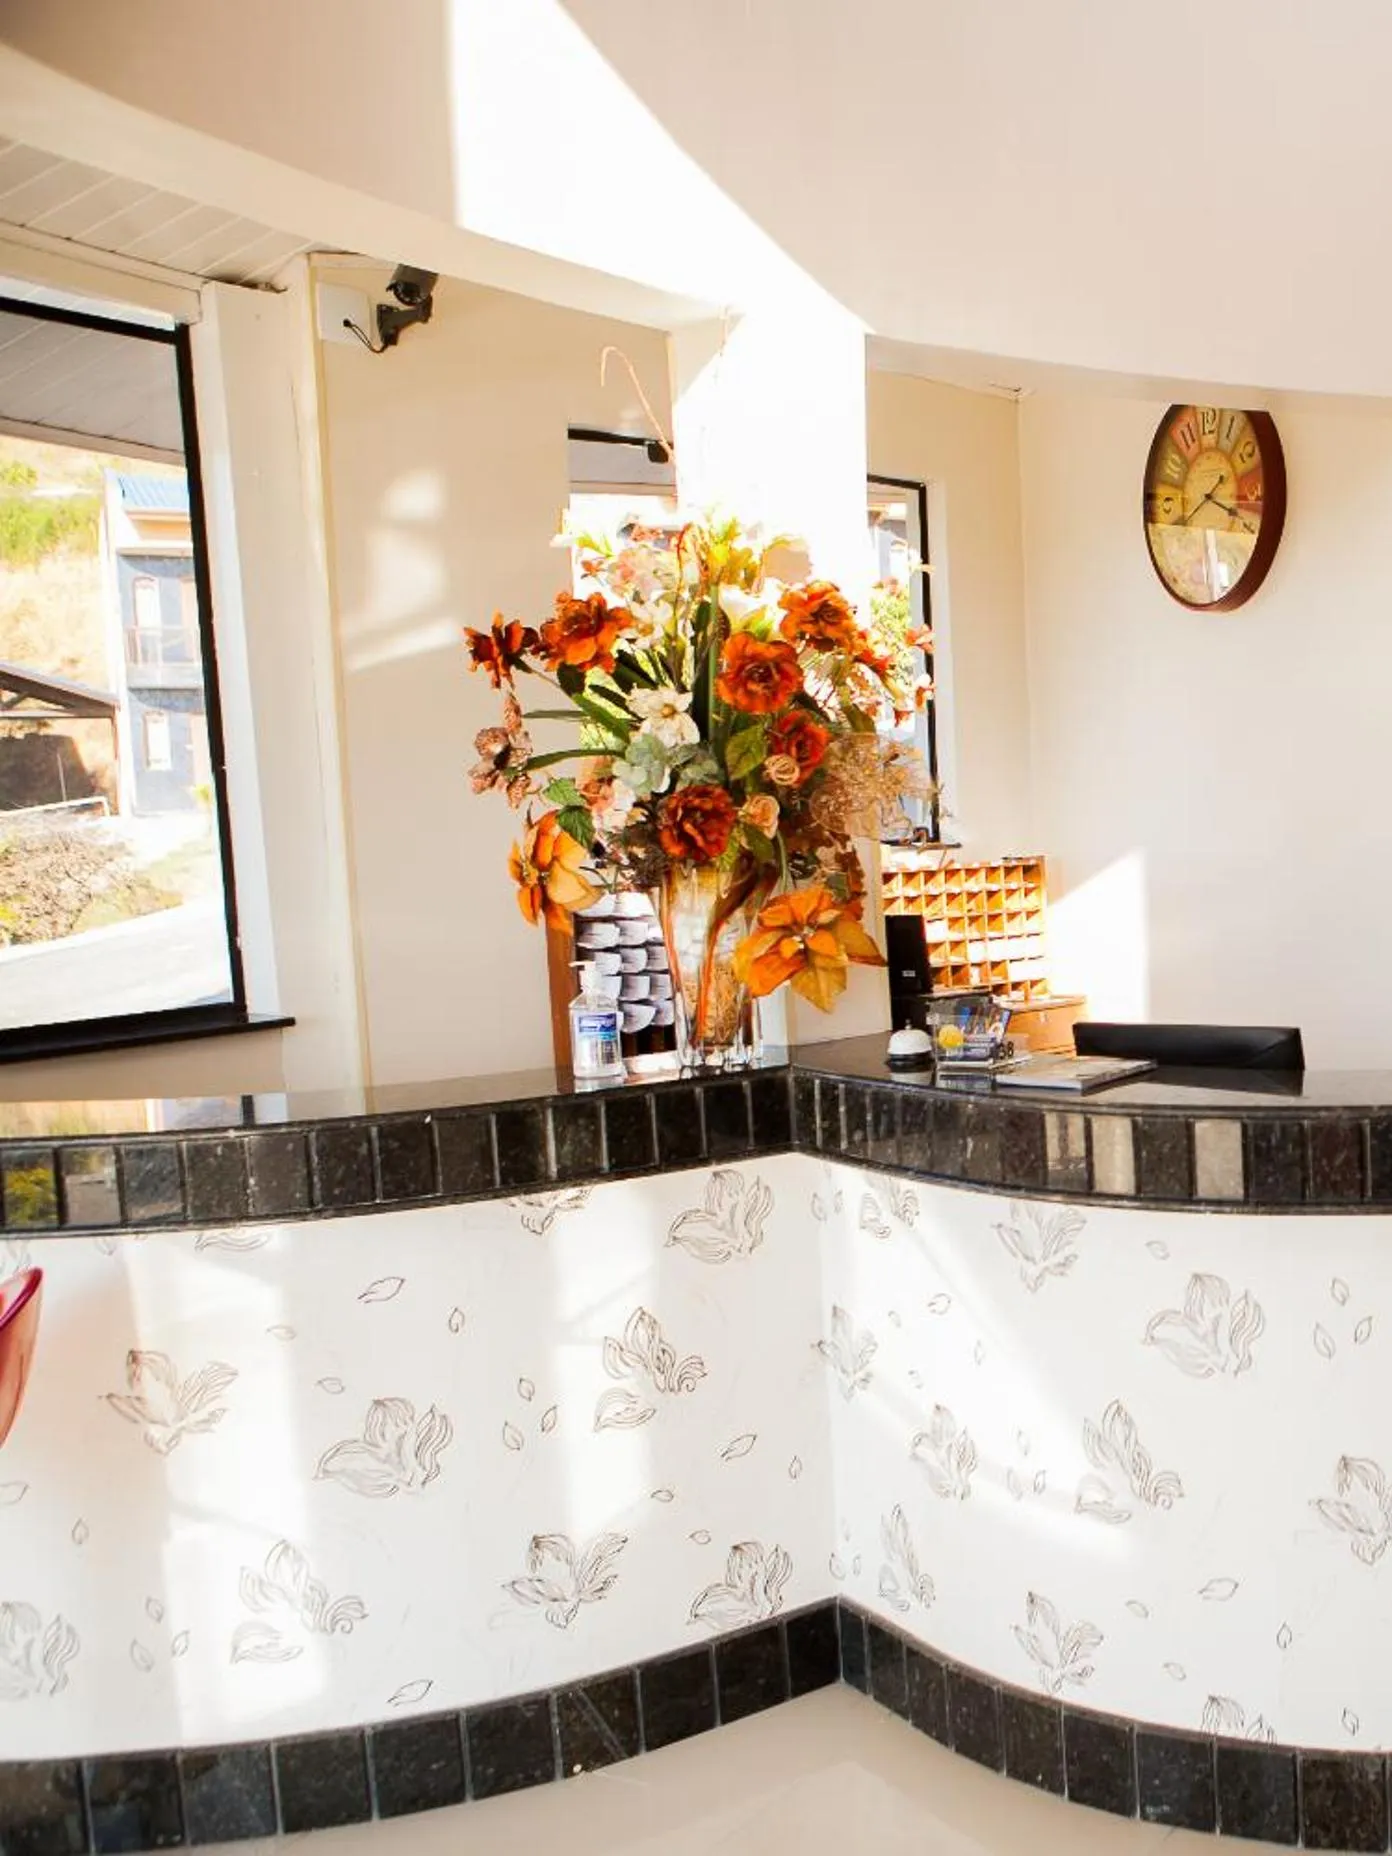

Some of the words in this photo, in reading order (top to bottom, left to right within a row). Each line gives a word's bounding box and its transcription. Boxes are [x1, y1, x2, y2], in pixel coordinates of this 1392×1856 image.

[1202, 408, 1216, 435] 12
[1226, 415, 1235, 438] 1
[1181, 422, 1196, 449] 11
[1239, 440, 1256, 463] 2
[1165, 453, 1181, 480] 10
